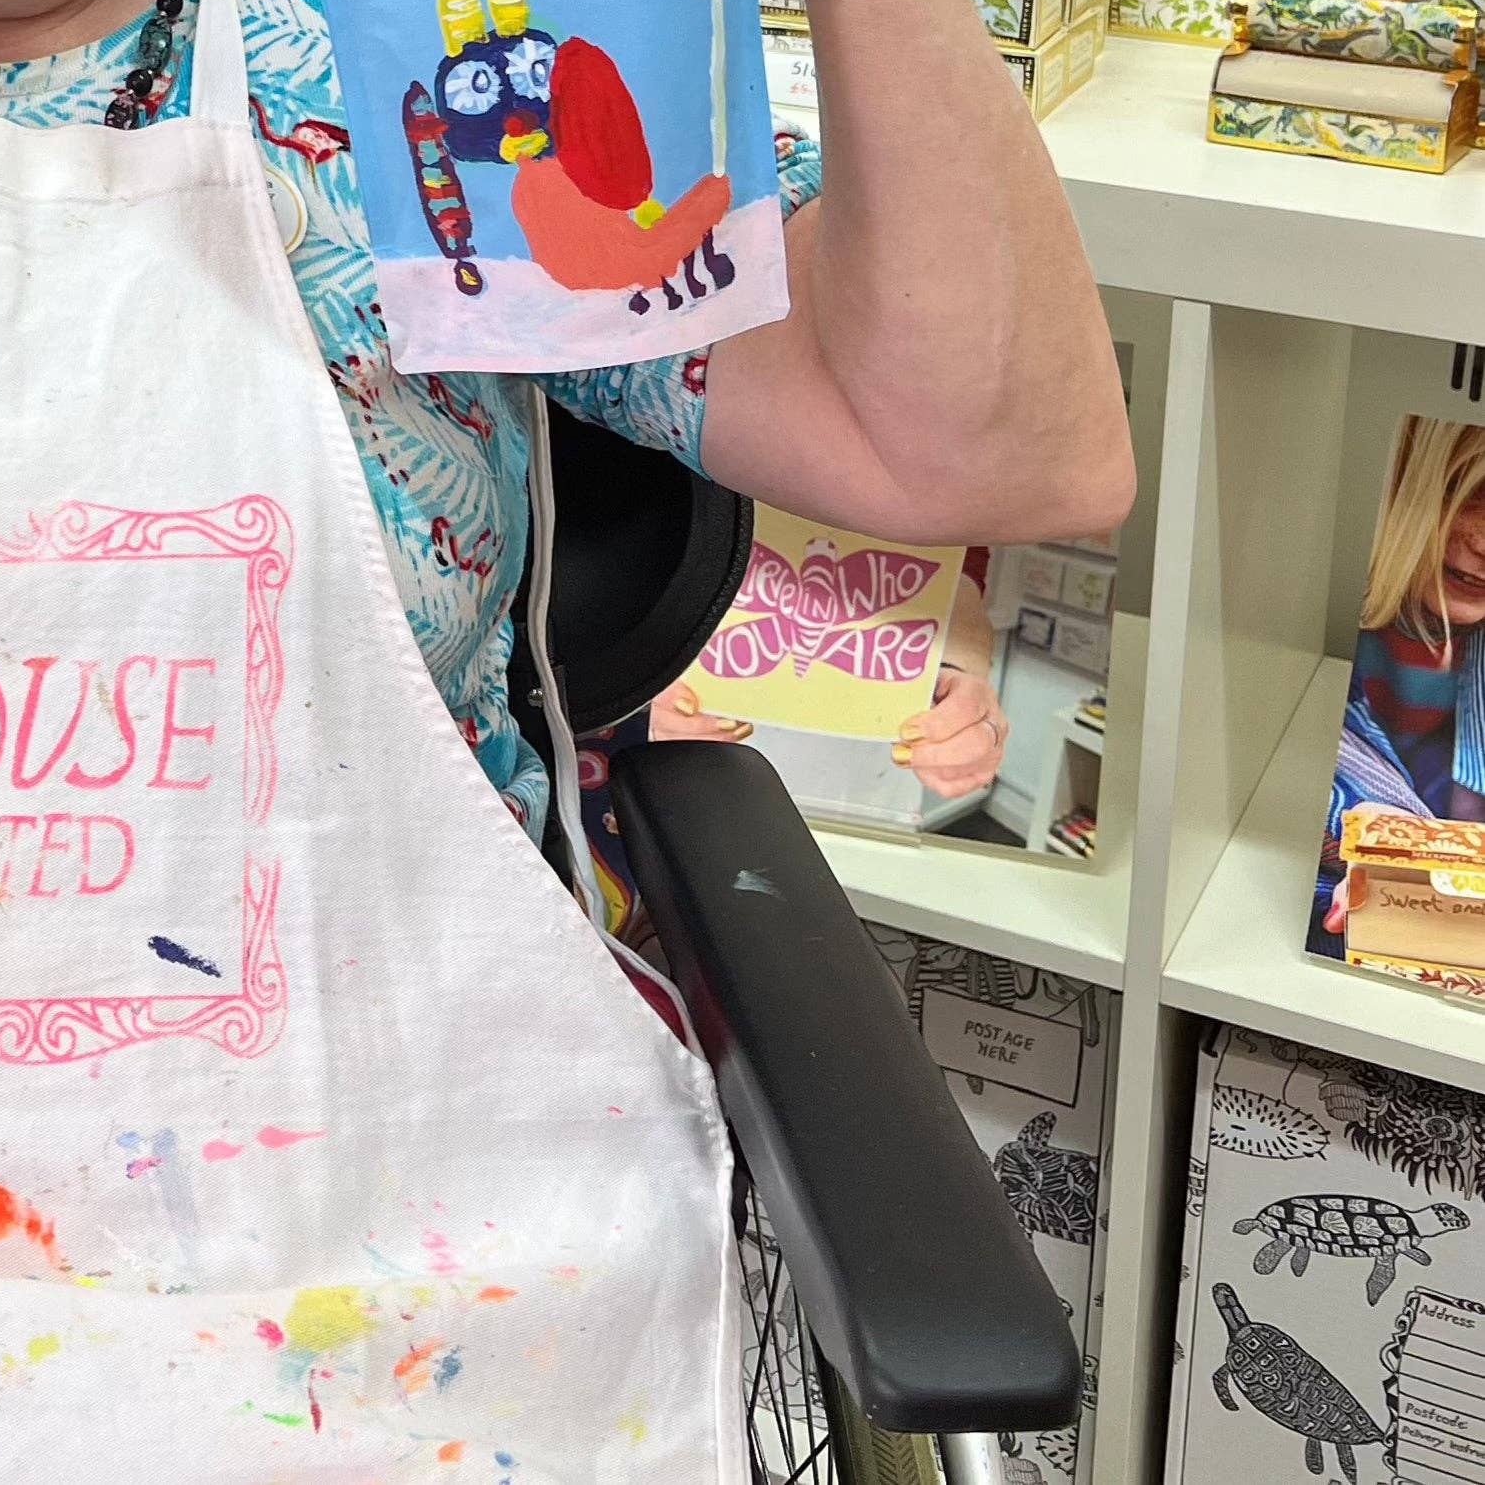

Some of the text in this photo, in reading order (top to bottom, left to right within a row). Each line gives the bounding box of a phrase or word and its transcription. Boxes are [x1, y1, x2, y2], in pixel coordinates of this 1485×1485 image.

[705, 615, 791, 677] YOU
[1379, 886, 1443, 913] Sweet
[977, 1041, 1019, 1065] HERE
[1420, 1304, 1476, 1330] Address
[1405, 1403, 1469, 1430] Postcode
[1401, 1425, 1445, 1448] Delivery
